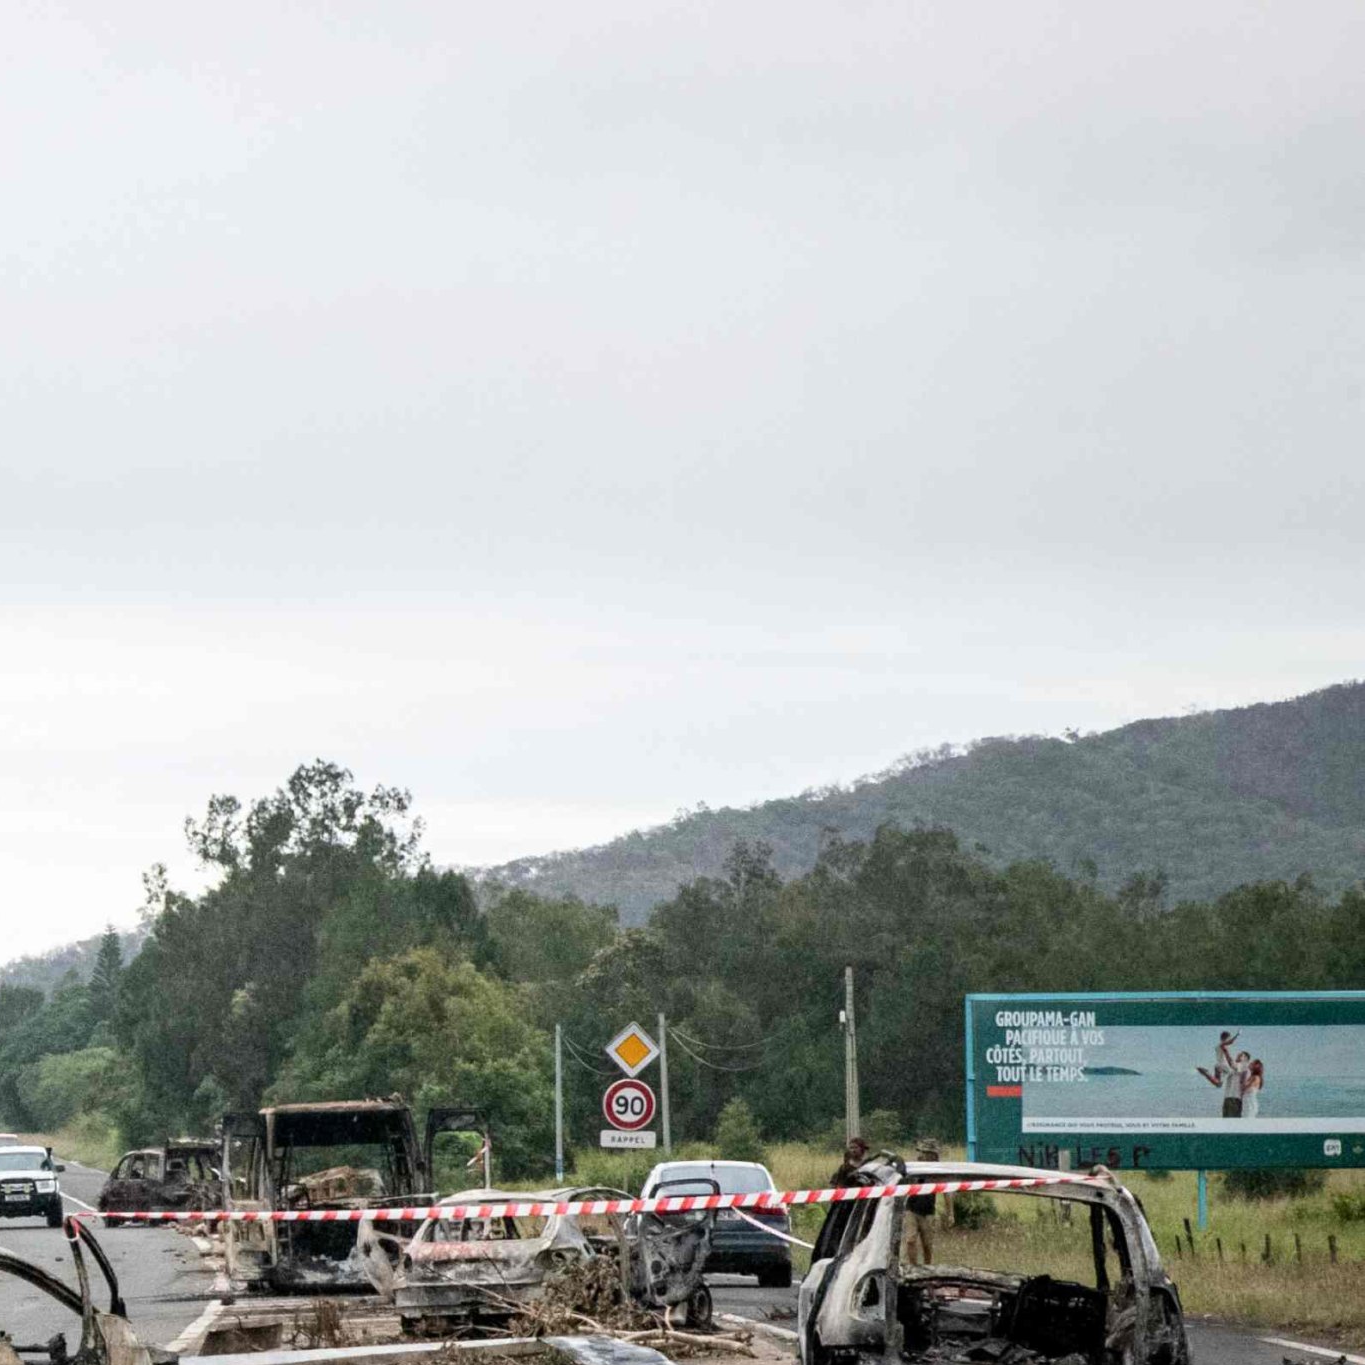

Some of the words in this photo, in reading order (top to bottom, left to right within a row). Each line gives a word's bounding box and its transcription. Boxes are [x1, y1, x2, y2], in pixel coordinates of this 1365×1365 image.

[995, 1011, 1096, 1027] GROUPAMA-GAN
[1005, 1030, 1067, 1046] PACIFIQUE
[1082, 1030, 1105, 1046] VOS
[986, 1044, 1025, 1065] CÔTÉS,
[996, 1066, 1025, 1082] TOUT
[1030, 1066, 1043, 1082] LE
[1046, 1066, 1088, 1082] TEMPS.
[615, 1096, 644, 1115] 90
[611, 1136, 646, 1144] RAPPEL
